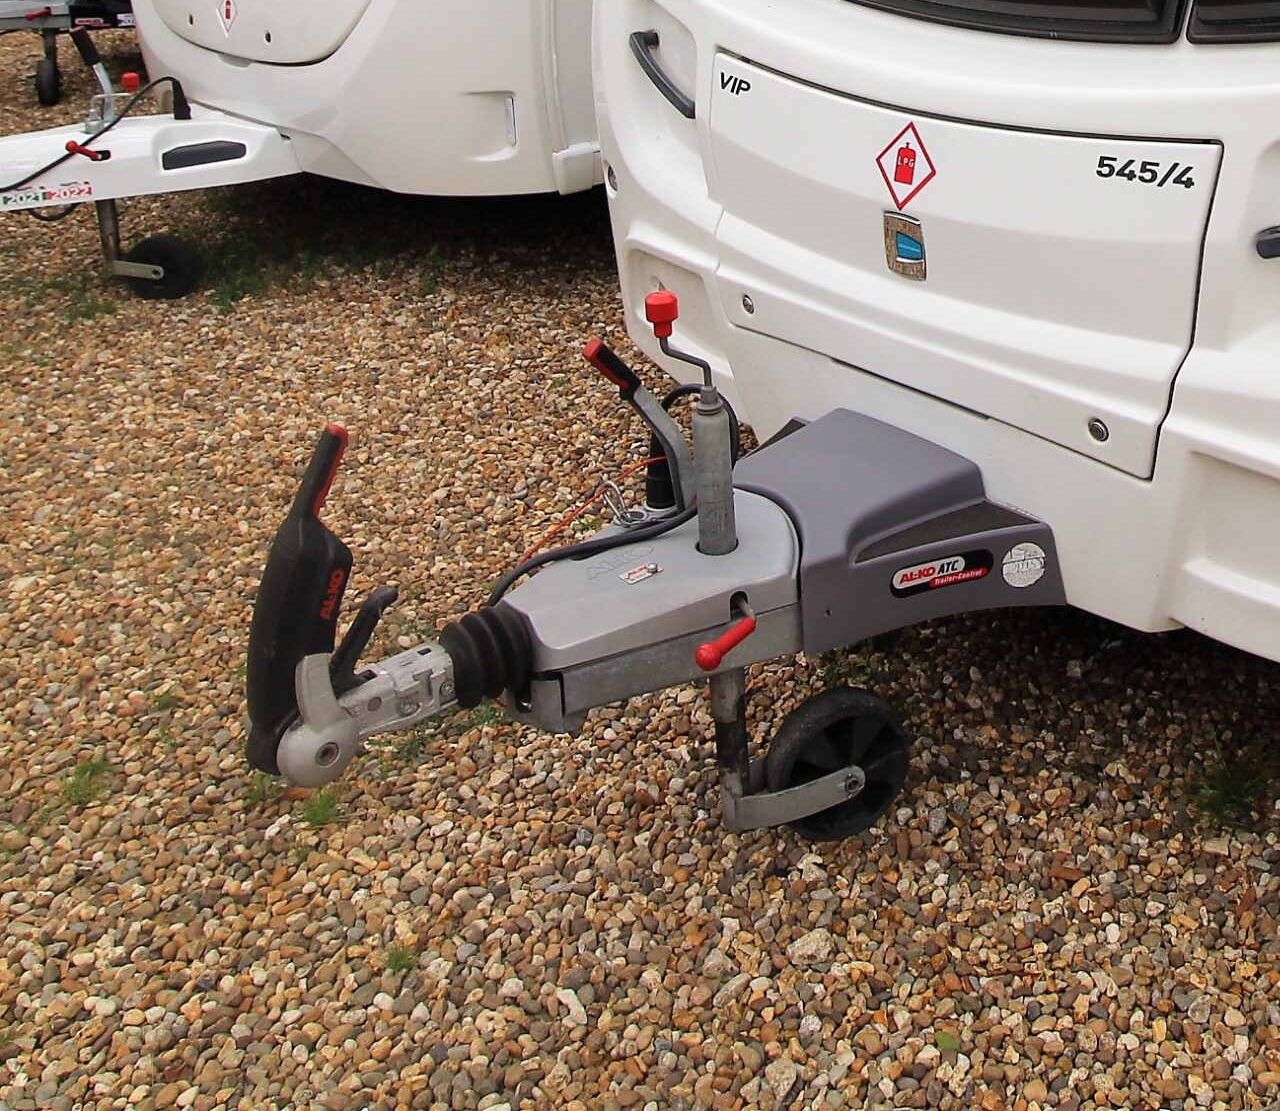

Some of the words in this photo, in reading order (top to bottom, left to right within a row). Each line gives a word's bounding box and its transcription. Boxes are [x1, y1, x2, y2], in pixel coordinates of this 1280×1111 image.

[720, 71, 751, 95] VIP
[897, 156, 915, 168] LPG
[1095, 155, 1195, 189] 545/4
[52, 187, 92, 200] 2022
[937, 559, 960, 575] ATC
